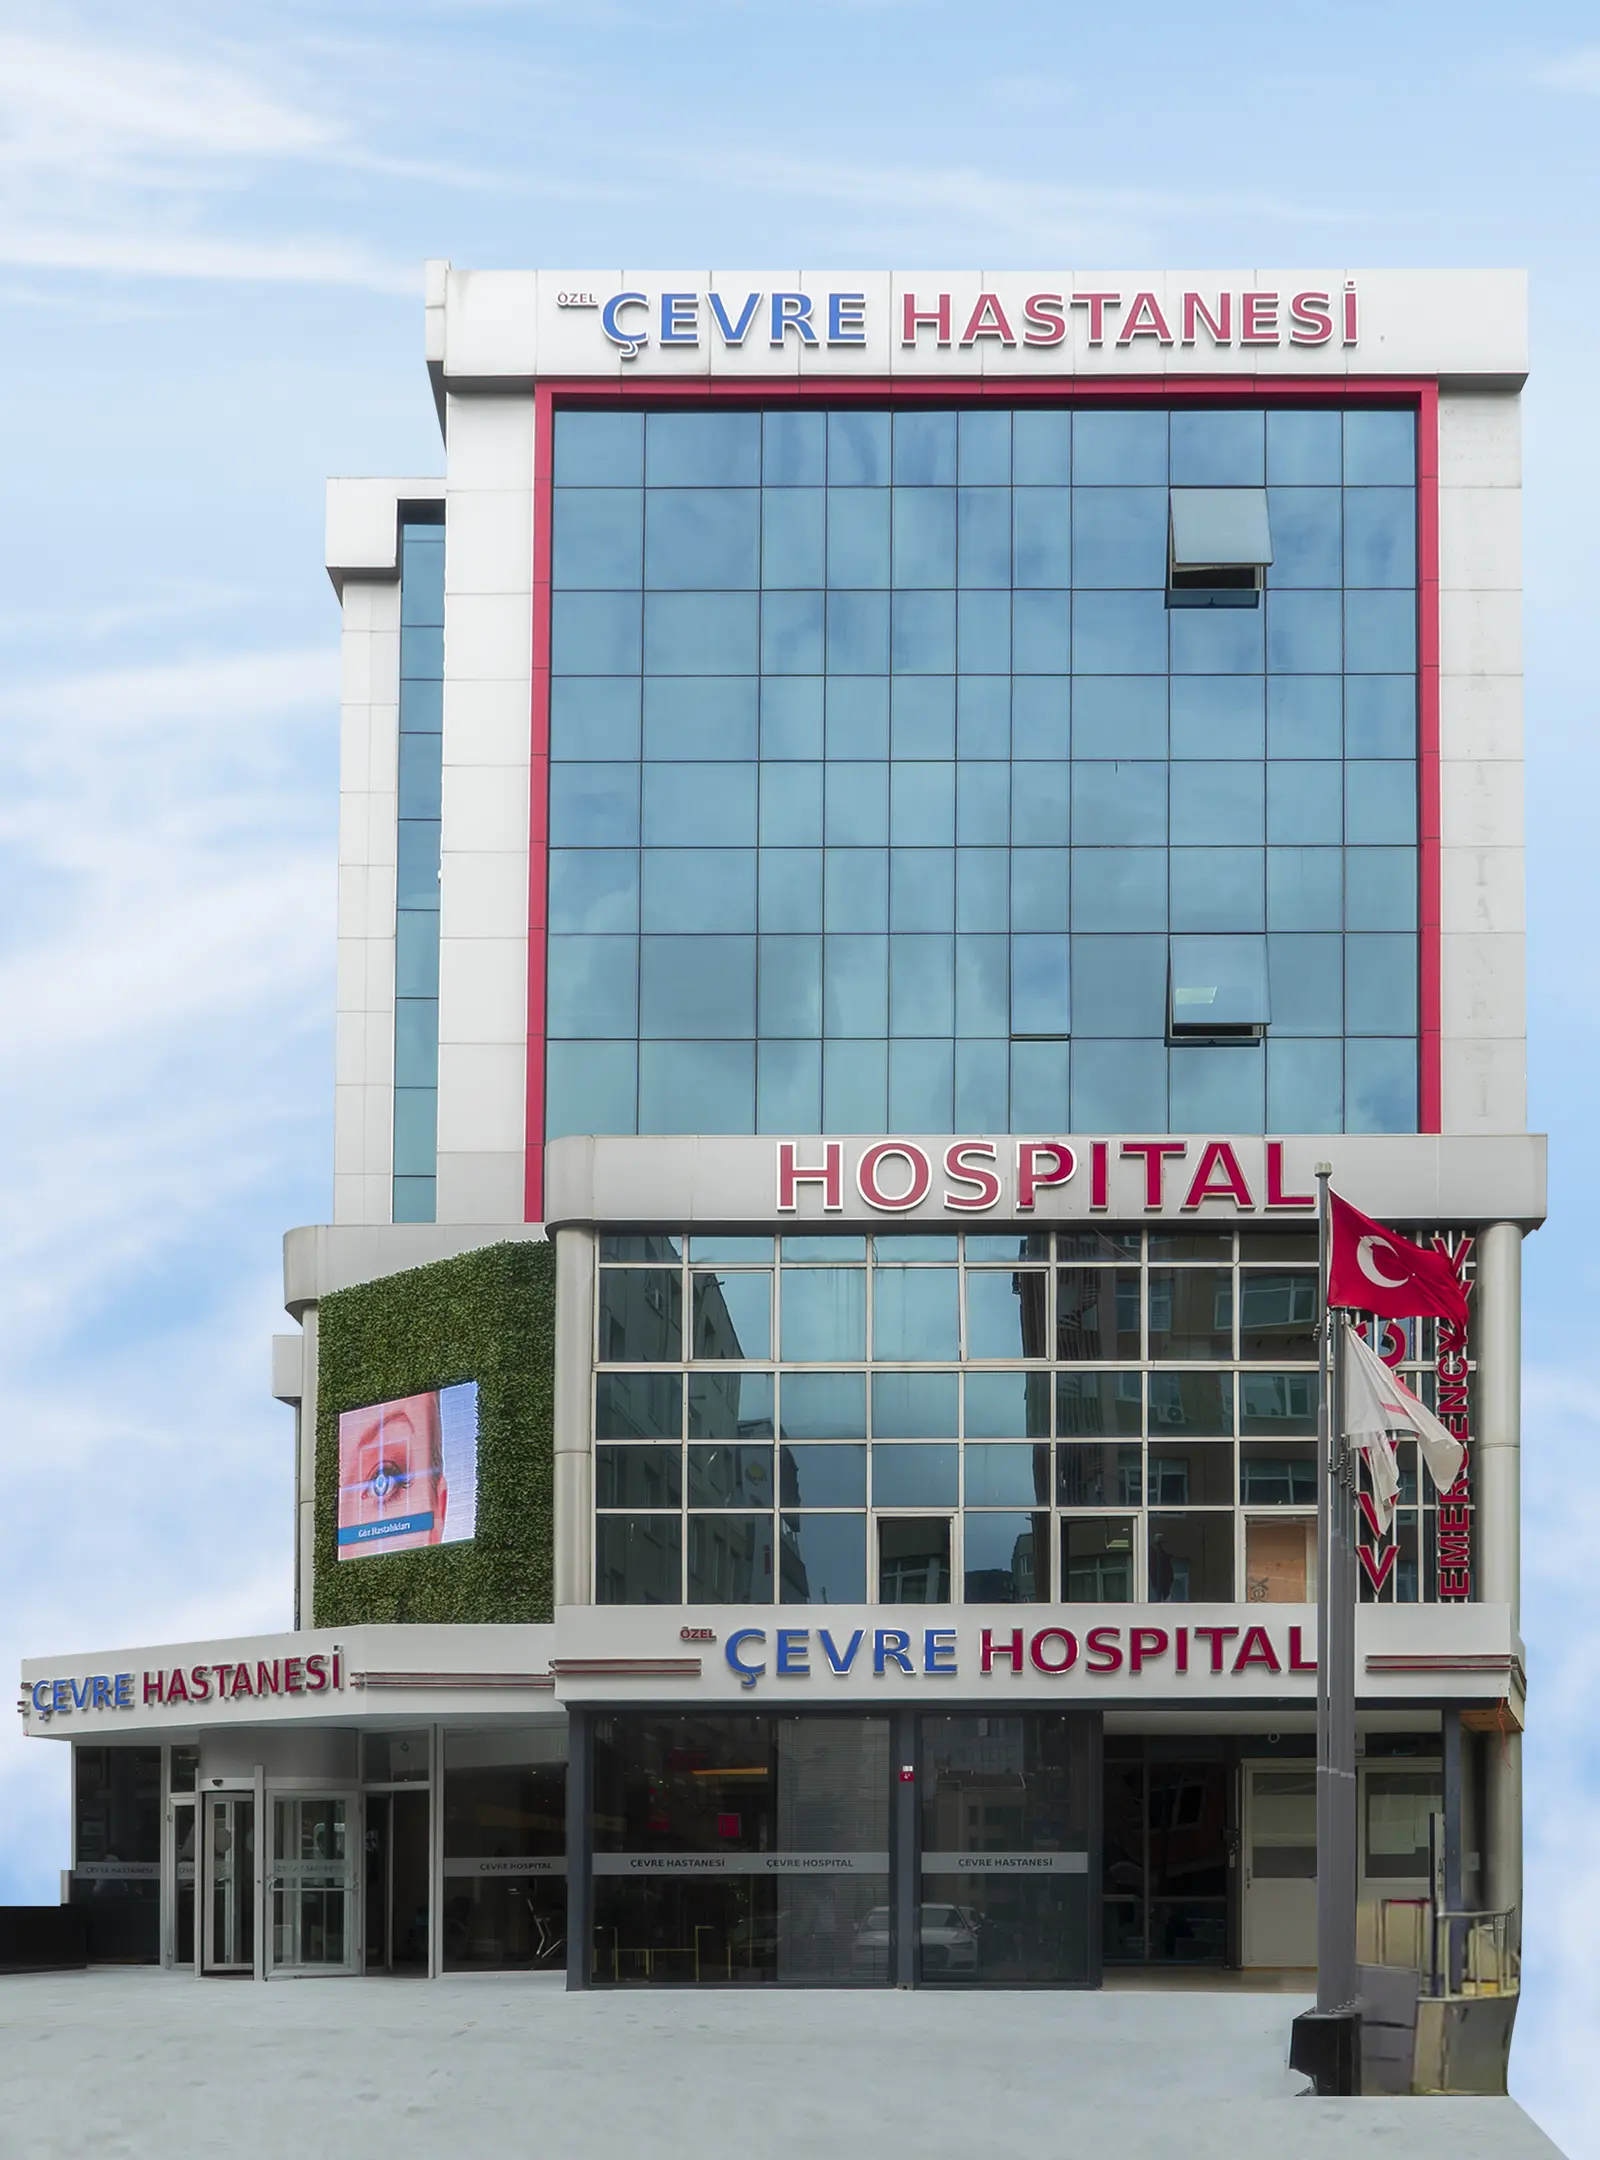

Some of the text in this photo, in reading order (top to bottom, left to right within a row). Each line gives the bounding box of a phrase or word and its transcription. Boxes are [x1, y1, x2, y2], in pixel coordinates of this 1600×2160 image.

[556, 279, 1361, 360] ÖZEL ÇEVRE HASTANESİ
[777, 1139, 1317, 1213] HOSPITAL
[680, 1625, 1319, 1689] ÖZEL ÇEVRE HOSPITAL
[32, 1645, 346, 1722] ÇEVRE HASTANESİ
[510, 1862, 553, 1870] HOSPITAL
[629, 1857, 726, 1869] ÇEVRE HASTANESİ
[765, 1858, 854, 1869] ÇEVRE HOSPITAL
[958, 1857, 1053, 1868] ÇEVRE HASTANESİ
